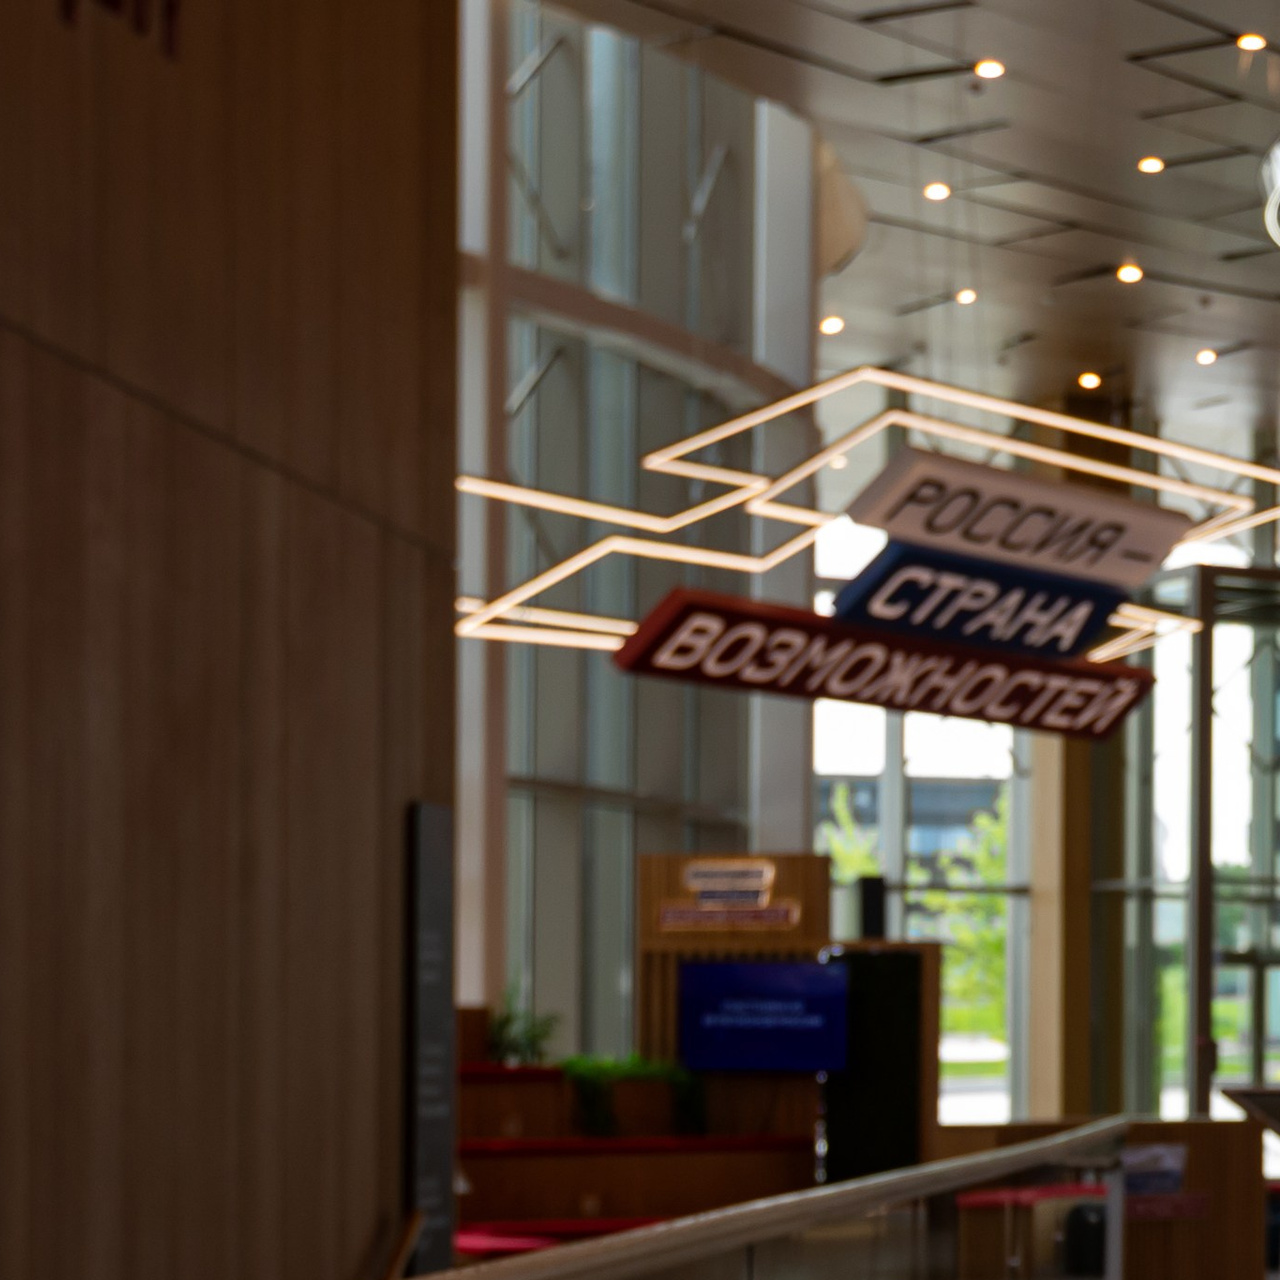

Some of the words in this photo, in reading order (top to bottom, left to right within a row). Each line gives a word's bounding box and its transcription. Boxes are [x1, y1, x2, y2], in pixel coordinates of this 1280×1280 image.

[885, 478, 1127, 568] РОССИЯ
[867, 565, 1095, 652] СТРАНА
[652, 612, 1140, 735] ВОЗМОЖНОСТЕЙ
